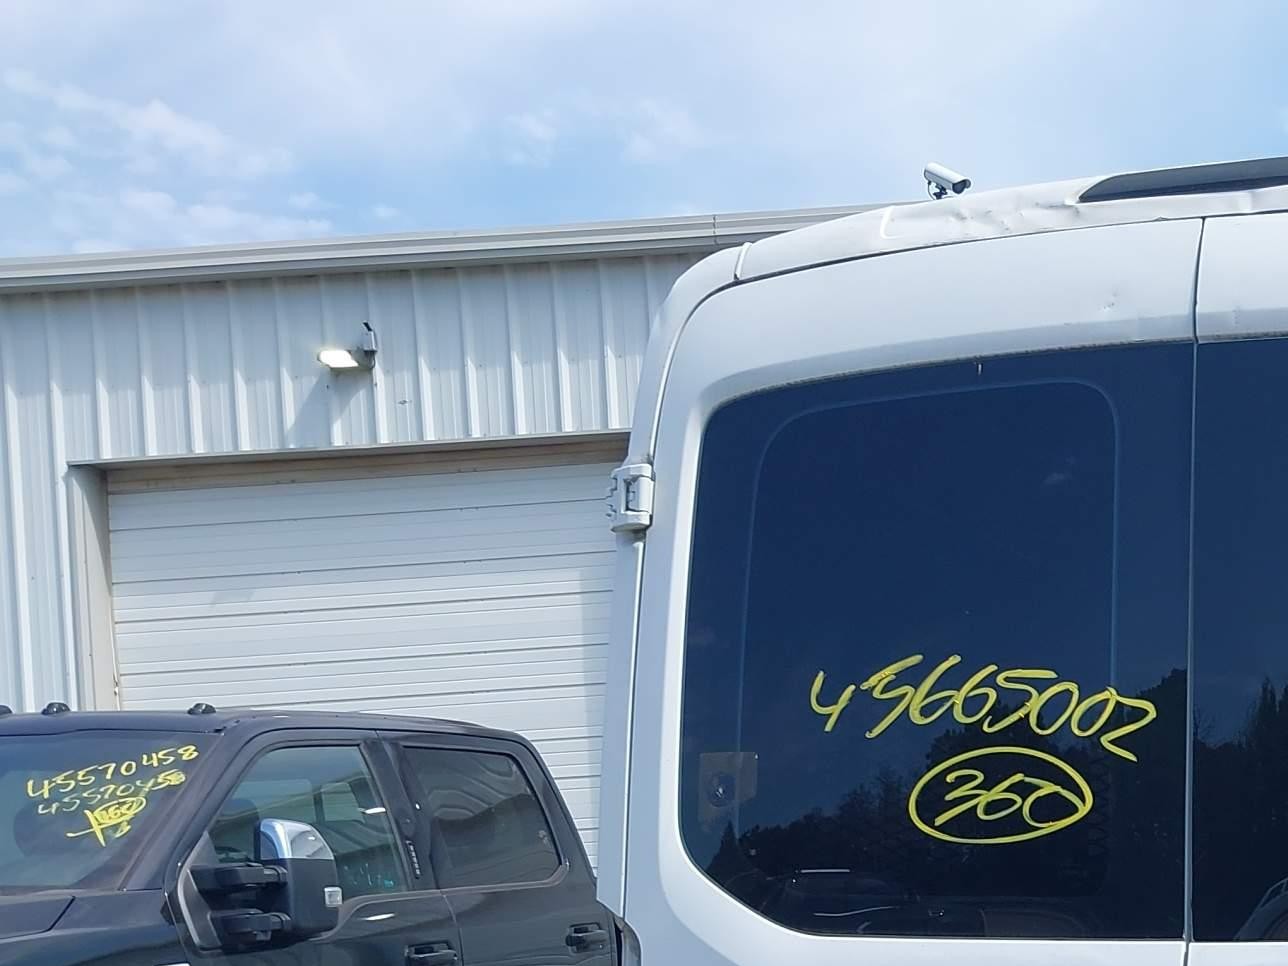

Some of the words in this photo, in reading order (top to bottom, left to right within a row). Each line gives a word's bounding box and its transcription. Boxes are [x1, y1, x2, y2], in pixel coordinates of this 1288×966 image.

[809, 654, 1157, 762] 45665002
[26, 745, 199, 799] 45570458
[934, 769, 1086, 828] 360
